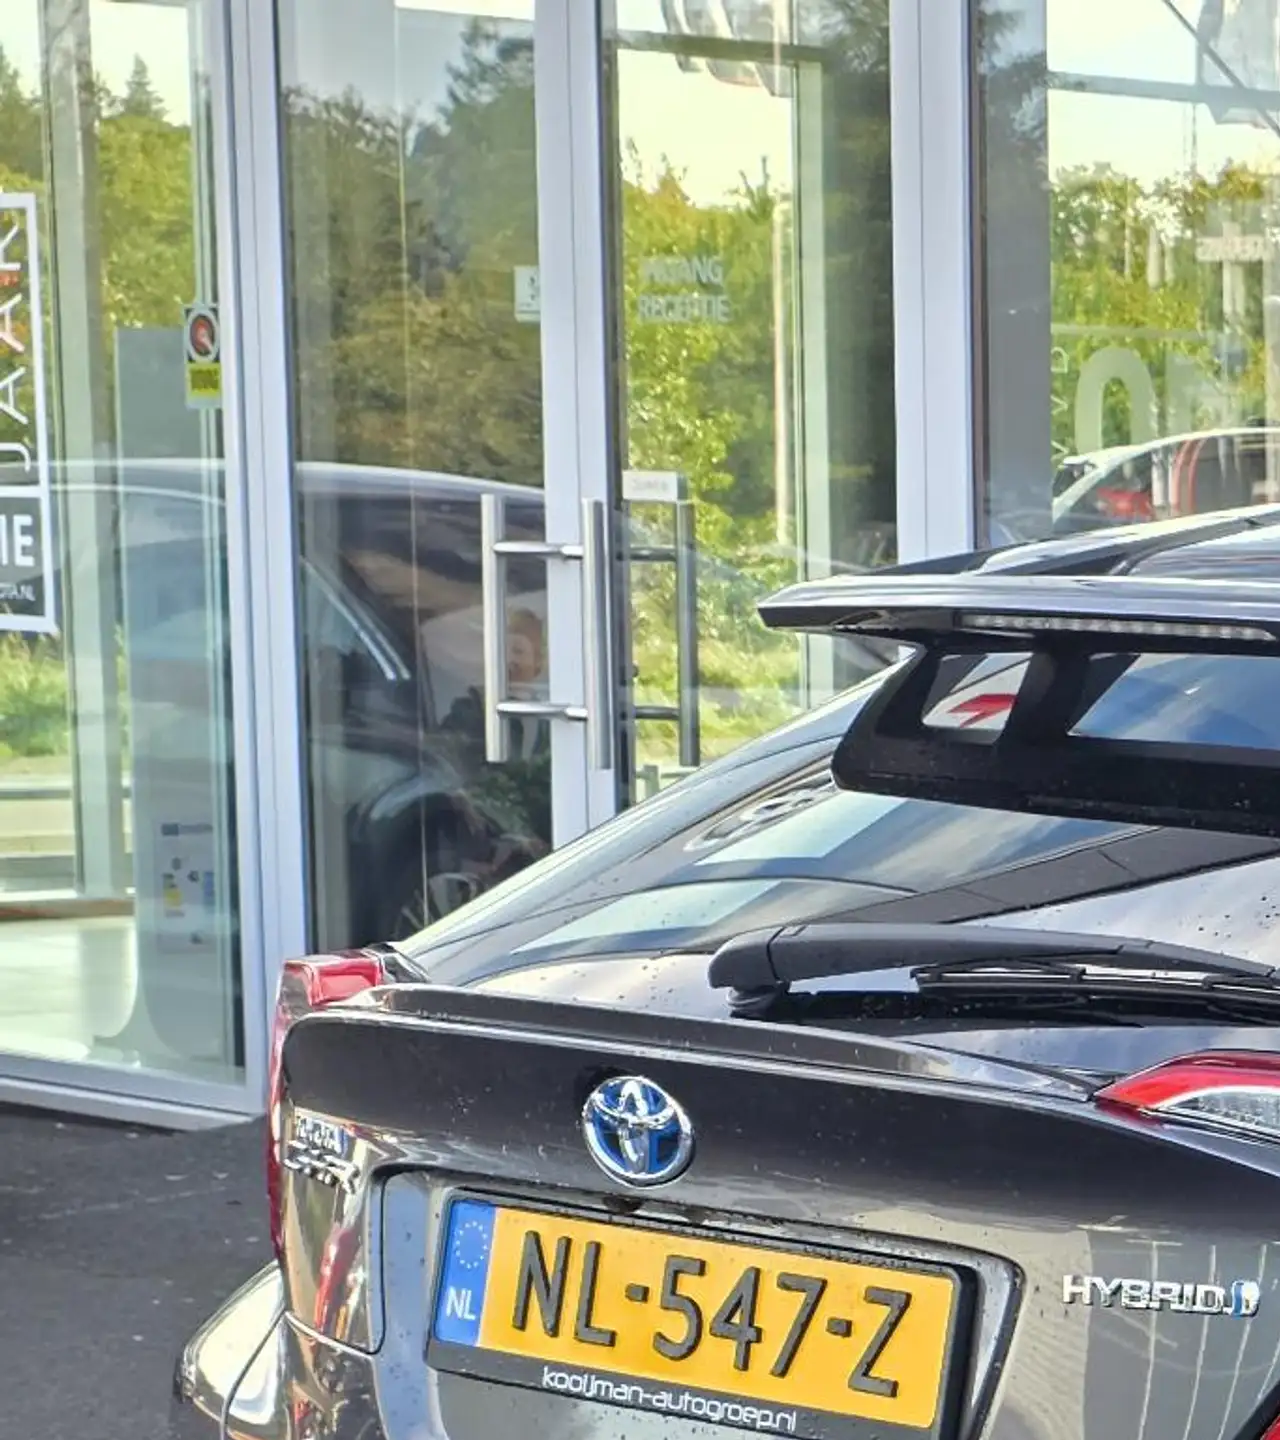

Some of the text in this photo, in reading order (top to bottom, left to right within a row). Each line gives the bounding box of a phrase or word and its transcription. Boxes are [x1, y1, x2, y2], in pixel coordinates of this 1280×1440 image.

[445, 1285, 477, 1321] NL
[511, 1229, 912, 1398] NL-547-Z
[1062, 1274, 1226, 1315] HYBRID
[542, 1366, 797, 1432] kooijman-autogroep.nl
